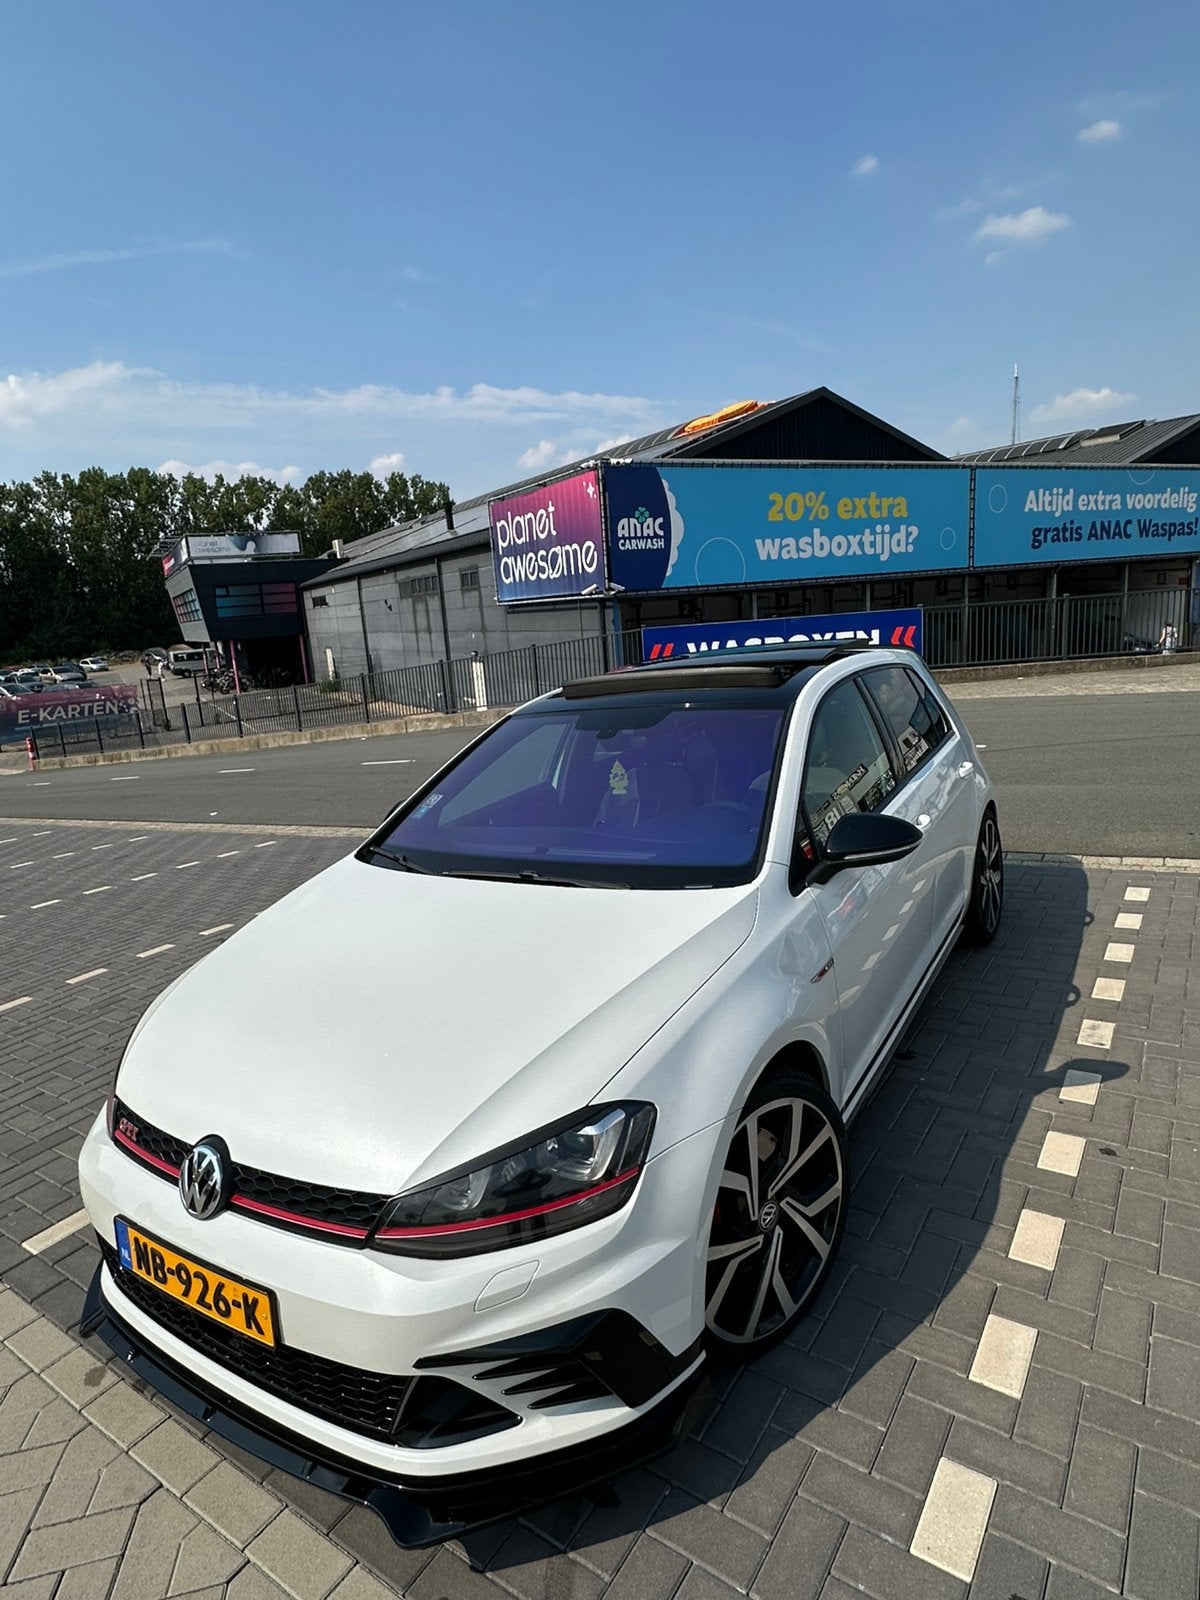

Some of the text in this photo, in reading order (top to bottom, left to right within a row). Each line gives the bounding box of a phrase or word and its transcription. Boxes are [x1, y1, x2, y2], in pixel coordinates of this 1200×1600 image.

[768, 491, 908, 521] 20% extra
[1024, 486, 1198, 517] Altijd extra voordelig
[496, 500, 557, 555] planet
[755, 524, 919, 562] wasboxtijd?
[1031, 517, 1199, 549] gratis ANAC Waspas!
[618, 538, 665, 550] CARWASH
[18, 700, 119, 724] E-KARTEN
[134, 1236, 265, 1336] NB-926-K
